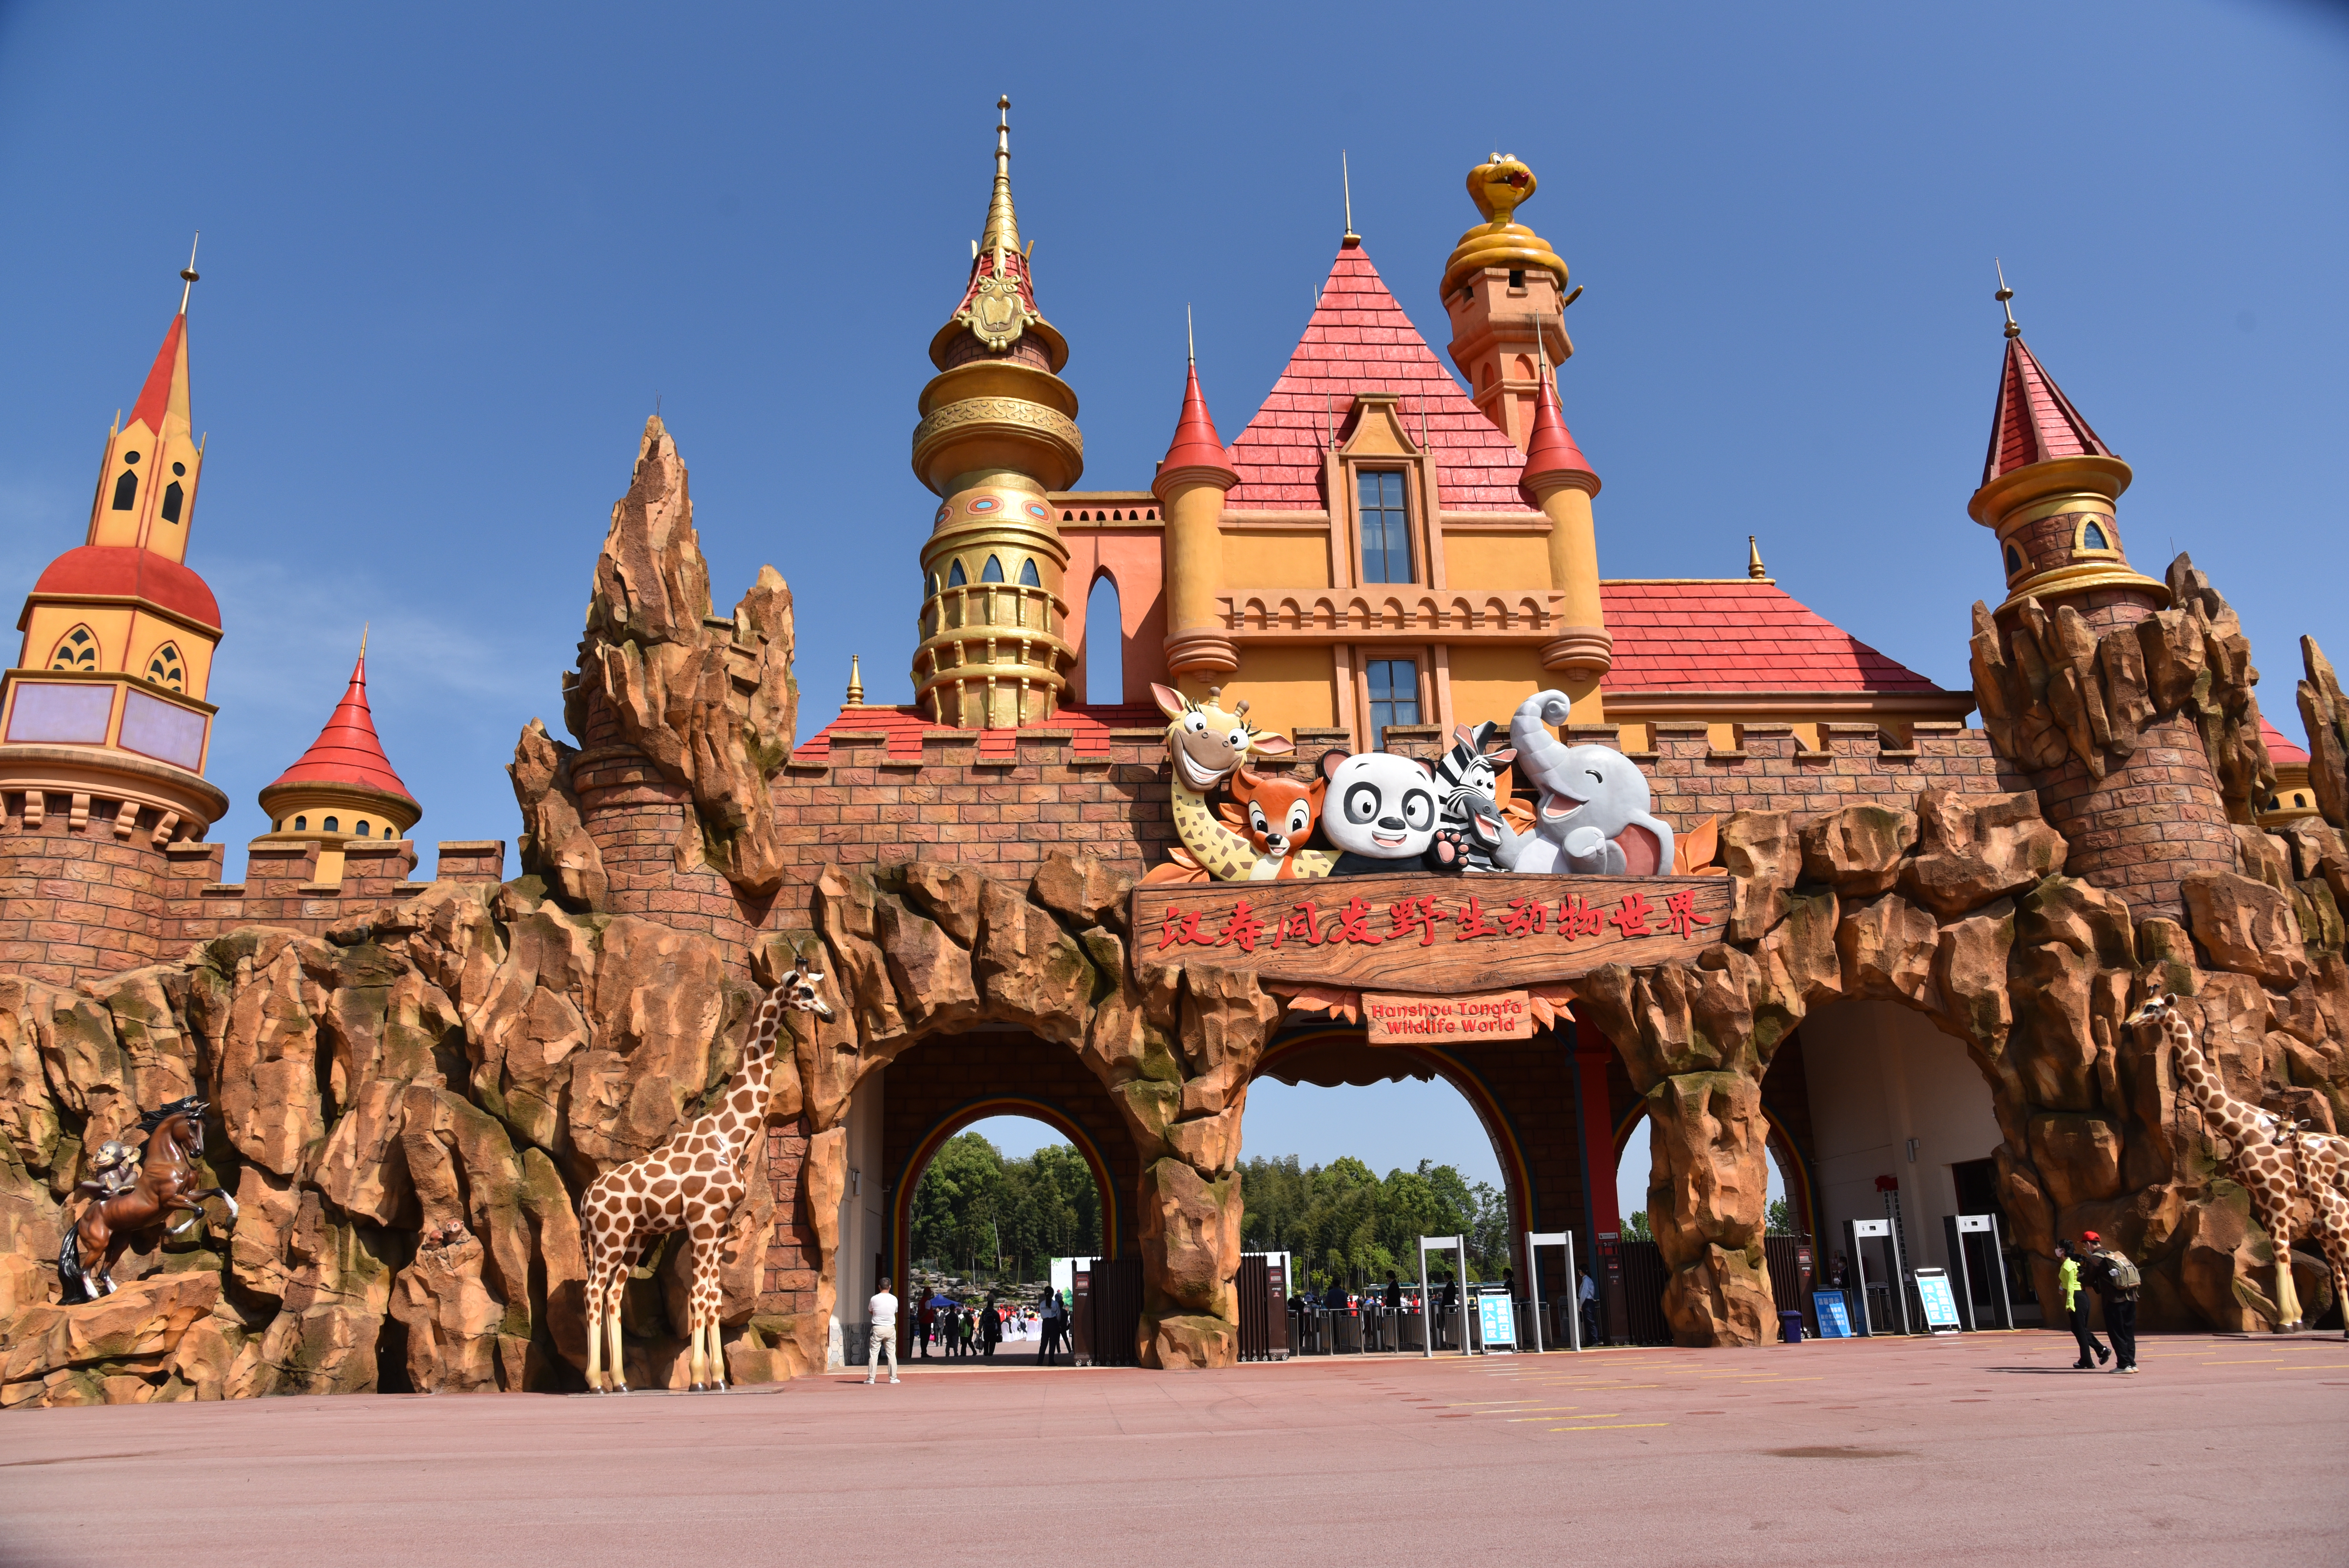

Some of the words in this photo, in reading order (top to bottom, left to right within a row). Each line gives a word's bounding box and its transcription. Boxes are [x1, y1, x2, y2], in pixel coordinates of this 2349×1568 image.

[1158, 890, 1712, 951] 汉寿同发野生动物世界
[1372, 1003, 1451, 1018] Hanshou
[1458, 999, 1522, 1017] Tongfa
[1387, 1018, 1455, 1033] Wildlife
[1462, 1017, 1515, 1032] World
[1483, 1303, 1497, 1338] 进入园区
[1495, 1299, 1511, 1340] 请佩戴口罩
